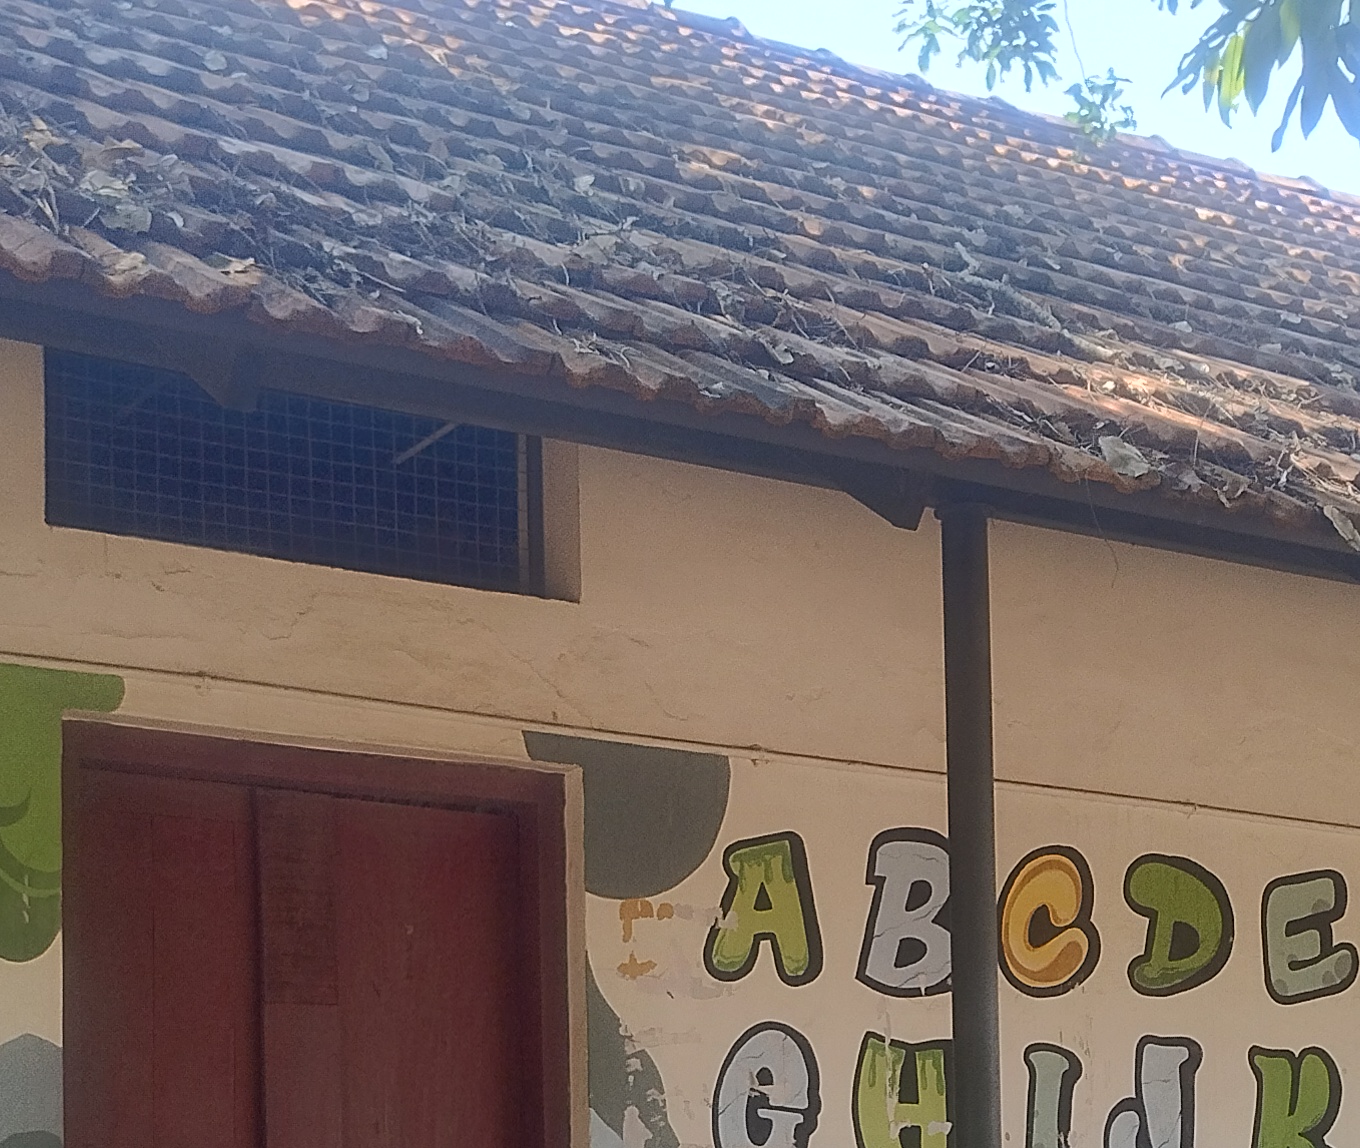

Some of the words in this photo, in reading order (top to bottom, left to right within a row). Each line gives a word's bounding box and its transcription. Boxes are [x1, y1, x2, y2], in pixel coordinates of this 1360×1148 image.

[704, 830, 823, 987] A
[855, 827, 952, 997] B
[996, 845, 1100, 998] C
[1124, 853, 1235, 998] D
[1261, 869, 1359, 1004] E
